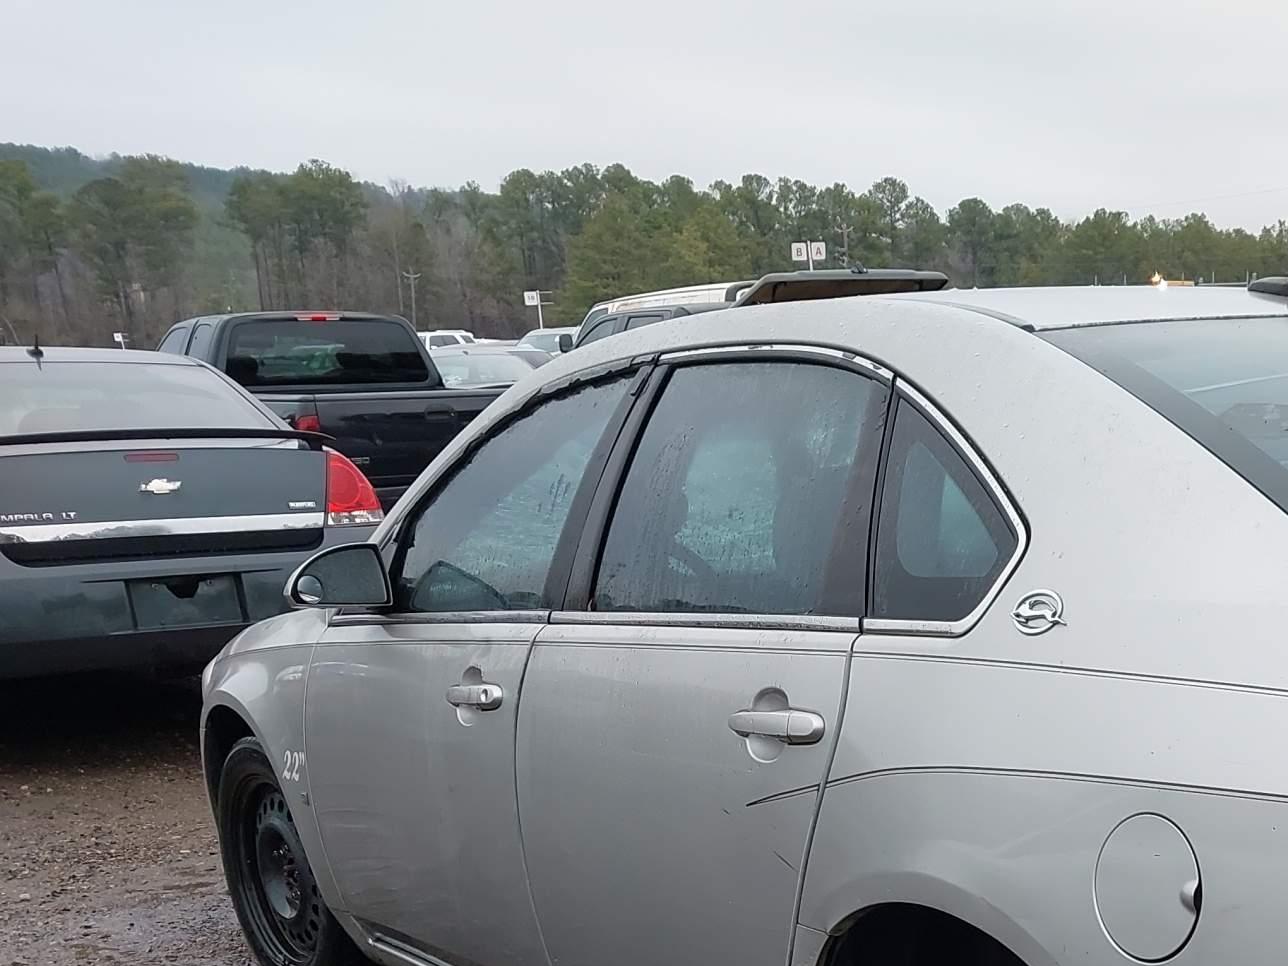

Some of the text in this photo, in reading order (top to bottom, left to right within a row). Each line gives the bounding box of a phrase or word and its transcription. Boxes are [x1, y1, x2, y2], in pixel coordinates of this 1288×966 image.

[796, 247, 803, 257] B
[815, 246, 823, 256] A
[0, 511, 77, 522] MPALA LT
